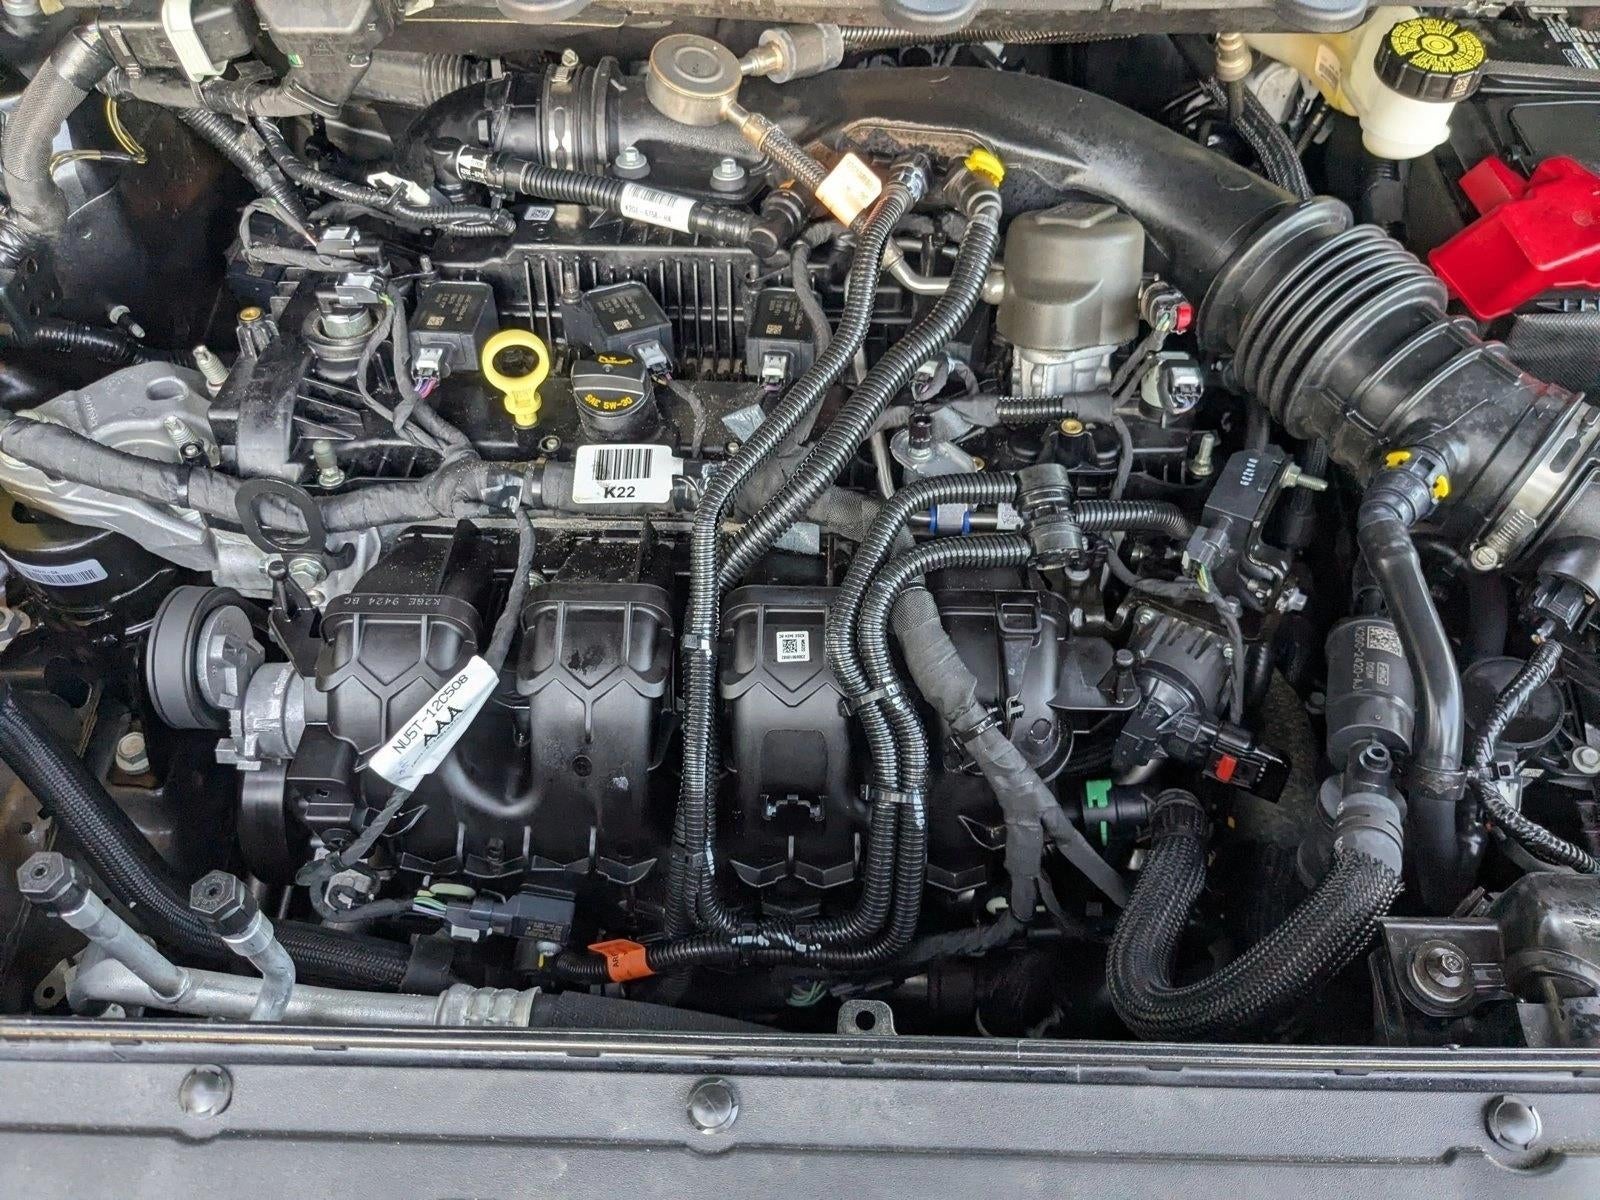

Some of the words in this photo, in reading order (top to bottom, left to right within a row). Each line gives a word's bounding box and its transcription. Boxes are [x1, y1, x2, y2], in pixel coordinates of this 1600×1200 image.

[584, 394, 601, 407] SAE
[603, 396, 633, 410] 5W-30
[604, 486, 635, 498] K22
[368, 596, 399, 606] 9424
[392, 674, 469, 754] NU5T-12C508
[423, 705, 463, 747] AAA
